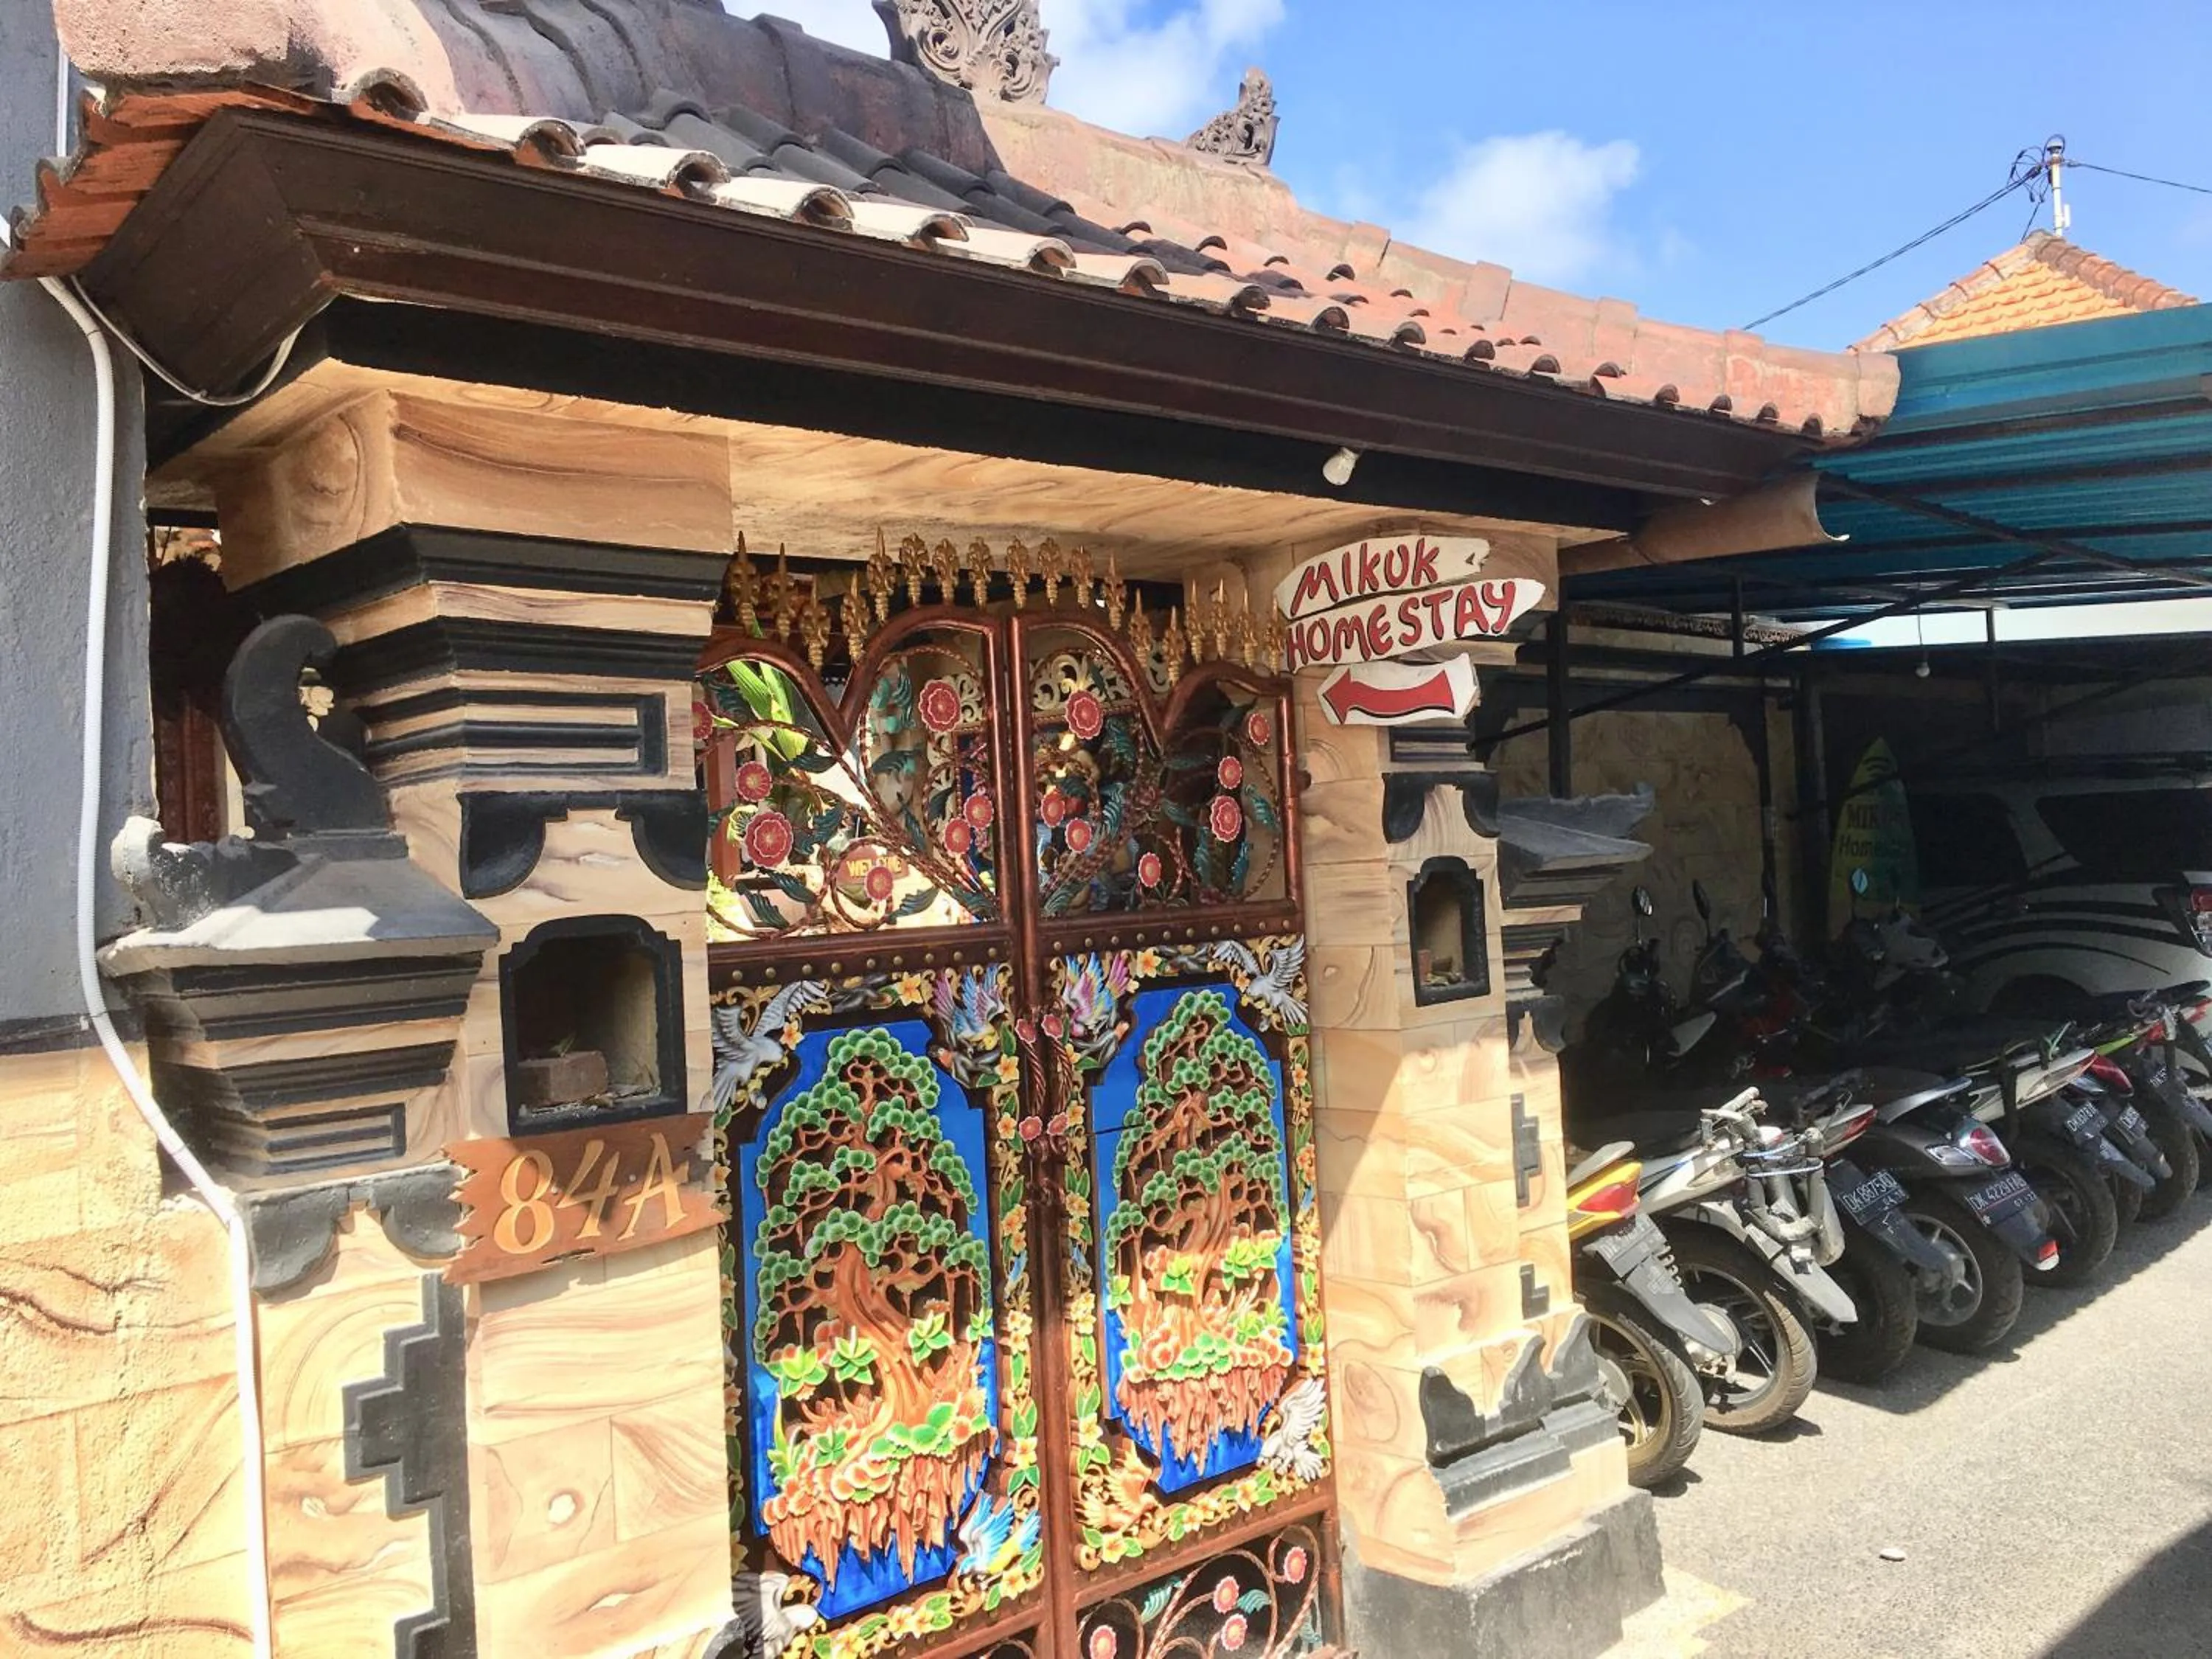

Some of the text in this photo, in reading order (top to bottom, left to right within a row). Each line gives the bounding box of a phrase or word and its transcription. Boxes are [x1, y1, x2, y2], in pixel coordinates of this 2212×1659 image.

[1290, 537, 1440, 616] MIKUK
[1839, 833, 1910, 858] Home
[493, 1133, 689, 1253] 84A
